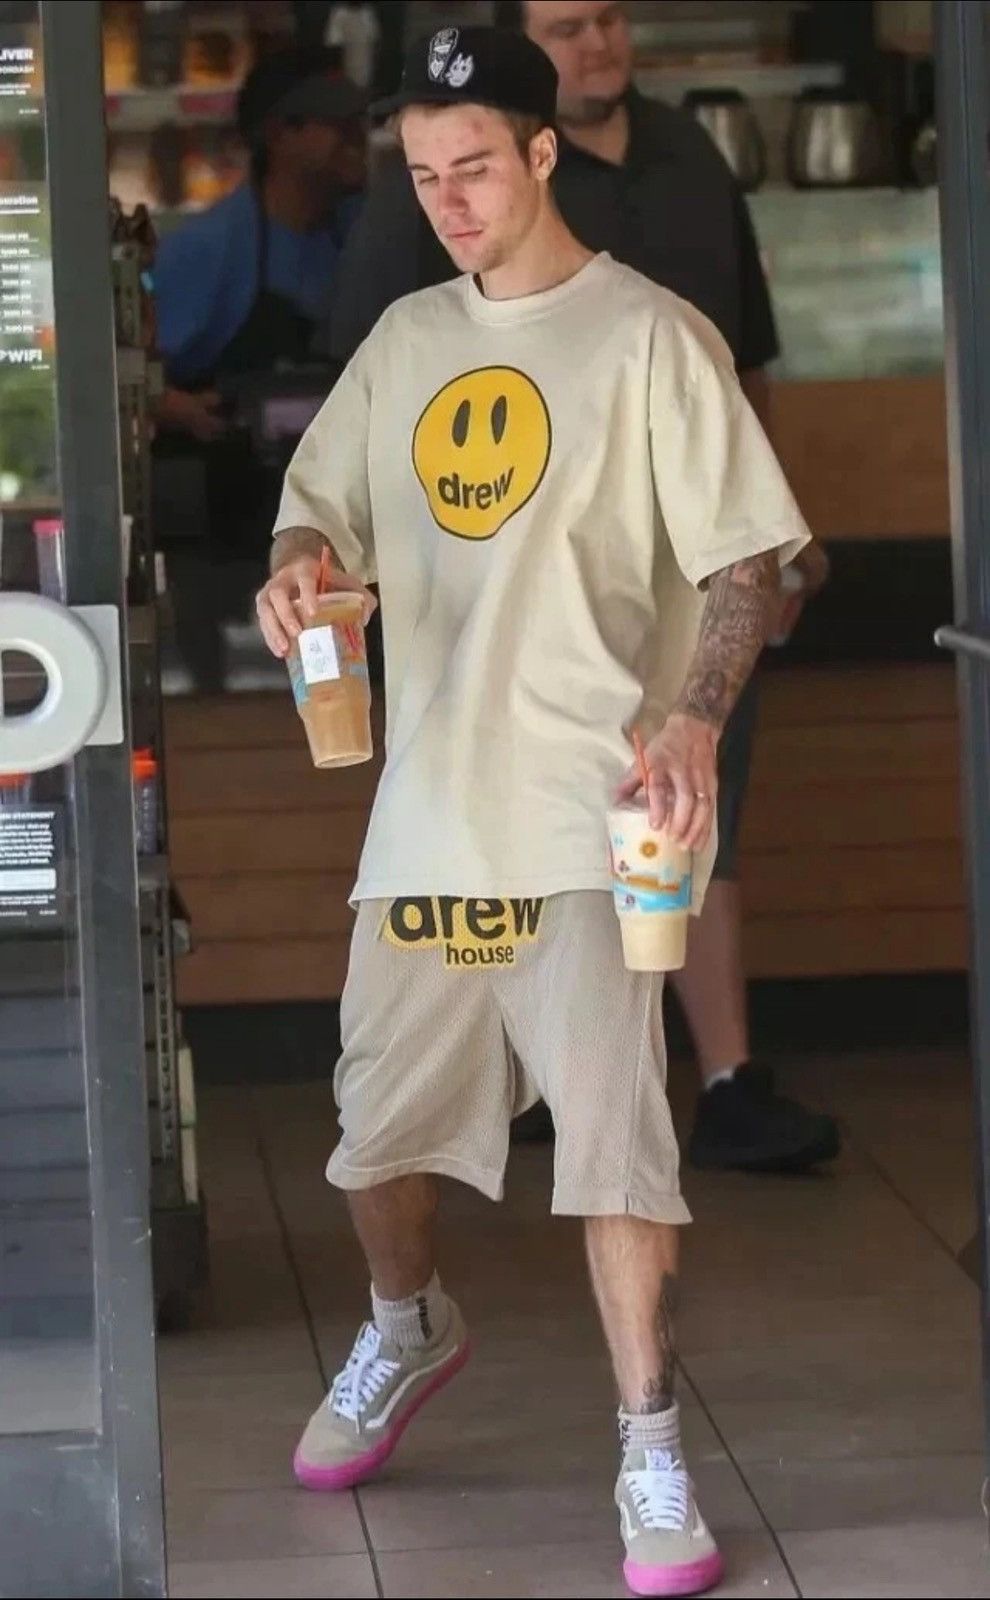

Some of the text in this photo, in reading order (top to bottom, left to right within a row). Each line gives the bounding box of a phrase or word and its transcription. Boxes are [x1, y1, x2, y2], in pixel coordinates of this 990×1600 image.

[0, 48, 34, 60] IVER
[438, 466, 515, 510] drew
[446, 942, 514, 965] house
